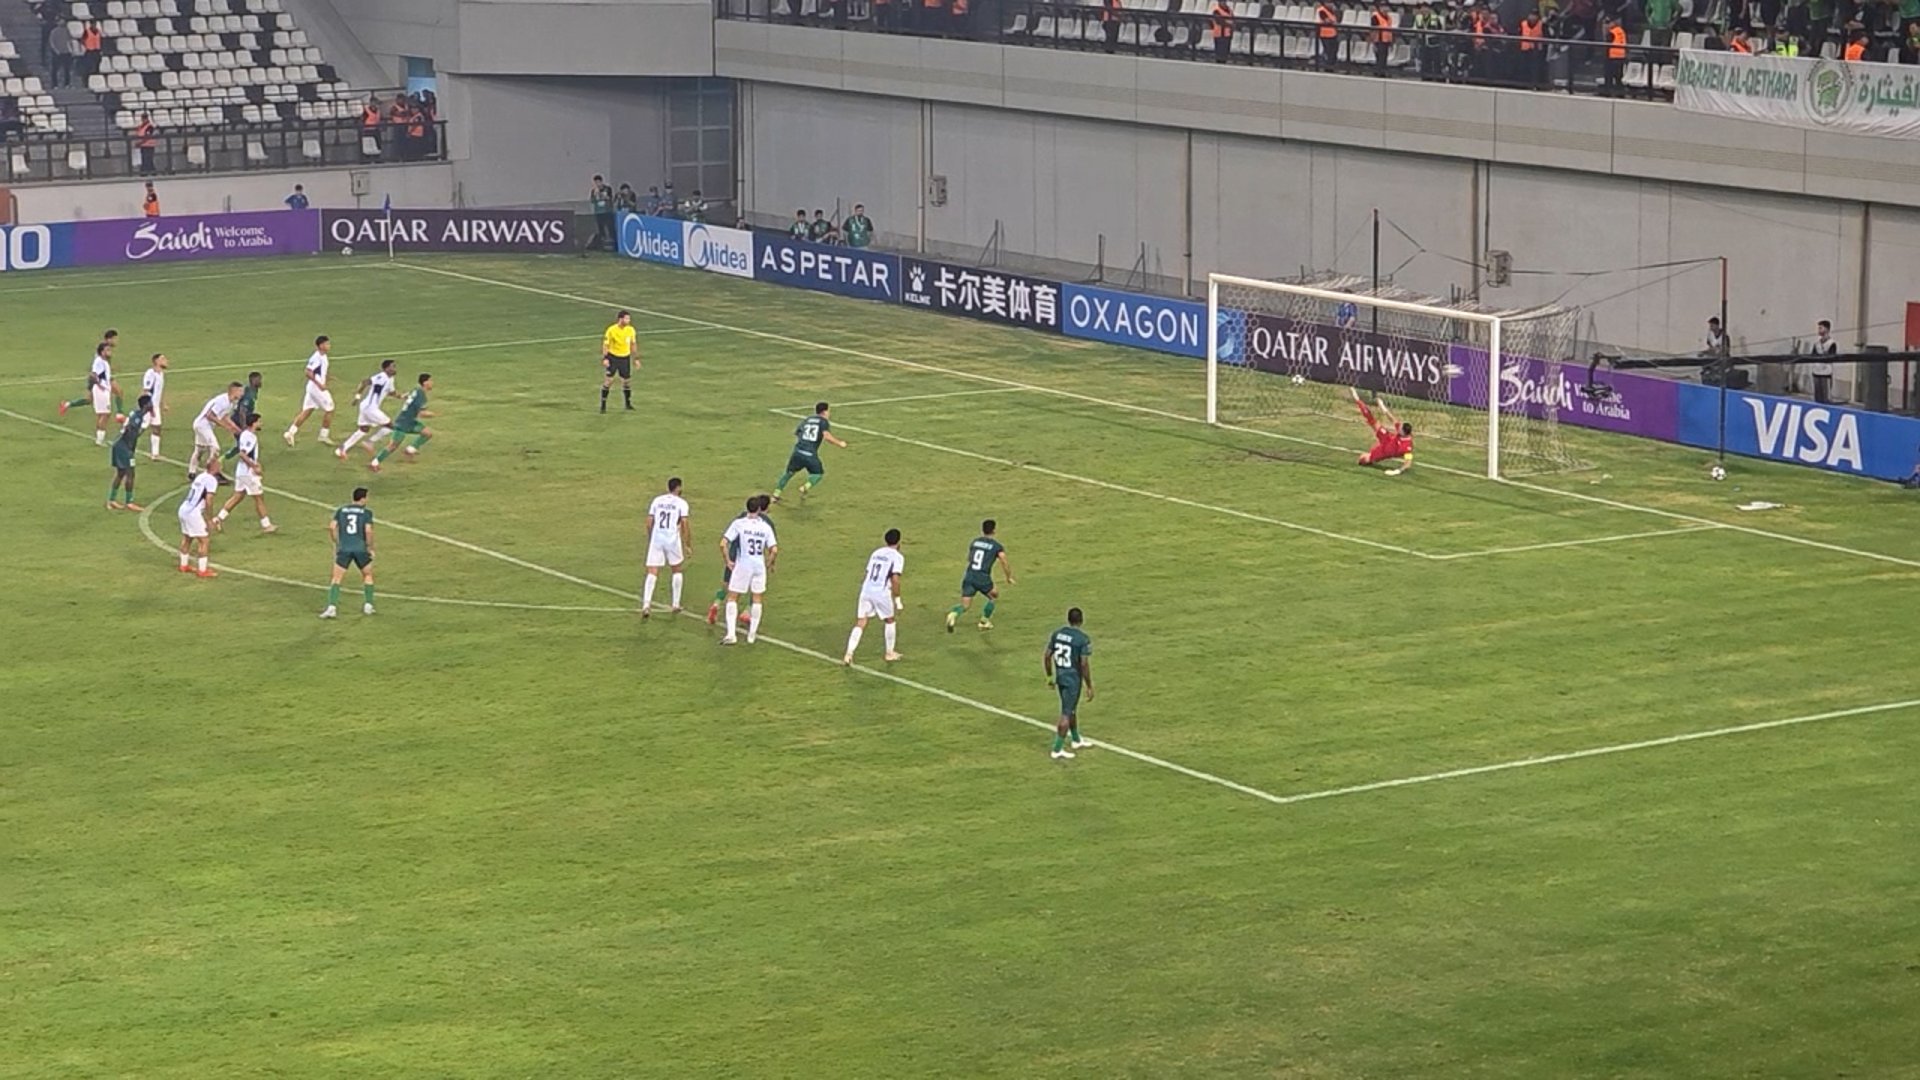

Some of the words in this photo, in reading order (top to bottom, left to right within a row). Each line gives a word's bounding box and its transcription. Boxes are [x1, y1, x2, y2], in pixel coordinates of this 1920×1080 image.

[215, 226, 264, 238] Welcome
[224, 237, 234, 248] to
[237, 234, 273, 247] Arabia
[331, 218, 429, 244] QATAR
[441, 219, 565, 244] AIRWAYS
[624, 216, 679, 259] Midea
[690, 227, 747, 271] Midea
[761, 245, 891, 296] ASPETAR
[934, 267, 1058, 326] 卡尔美体育
[1070, 294, 1198, 347] OXAGON
[1252, 327, 1330, 367] QATAR
[1338, 343, 1441, 384] AIRWAYS
[1582, 400, 1595, 415] to
[1595, 403, 1630, 420] Arabia
[802, 424, 819, 441] 33
[1742, 397, 1862, 470] VISA
[346, 514, 357, 534] 3
[659, 511, 670, 529] 21
[747, 539, 762, 555] 33
[972, 550, 985, 570] 9
[1054, 643, 1072, 668] 23
